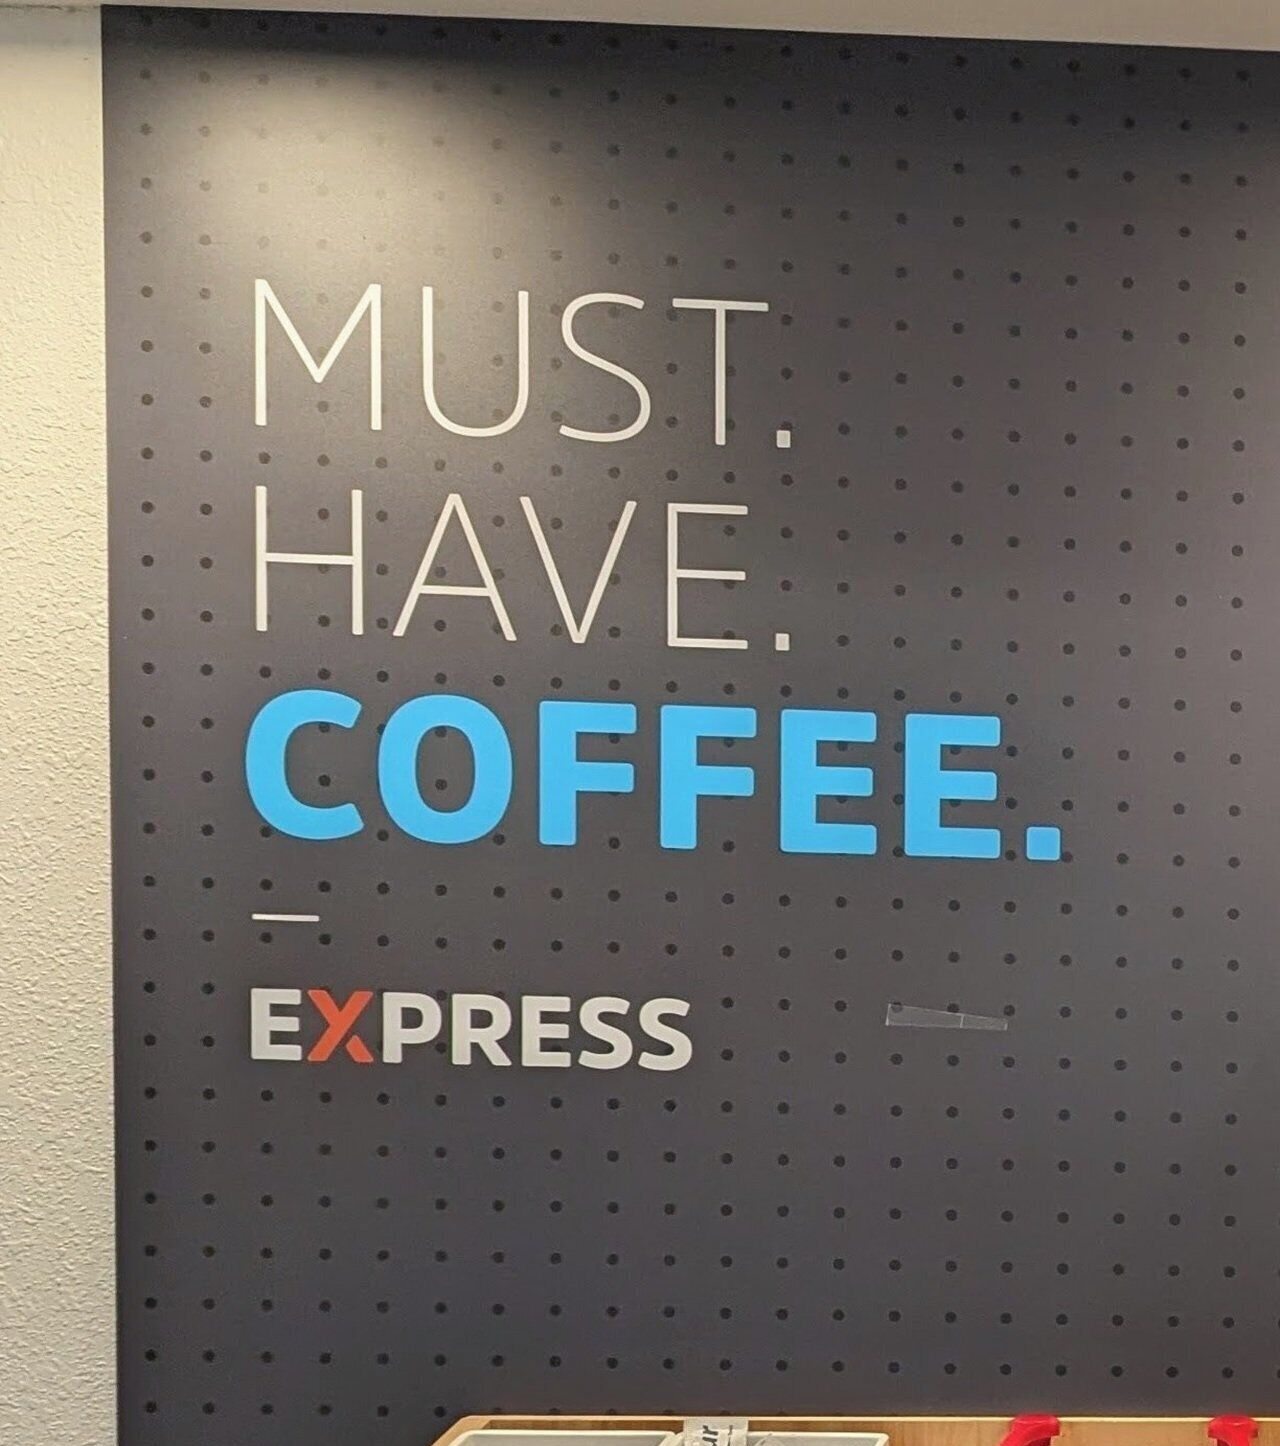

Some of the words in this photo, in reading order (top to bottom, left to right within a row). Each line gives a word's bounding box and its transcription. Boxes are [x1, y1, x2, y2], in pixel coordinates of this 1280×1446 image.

[254, 278, 792, 449] MUST.
[254, 485, 790, 652] HAVE.
[244, 689, 1062, 862] COFFEE.
[249, 987, 693, 1072] EXPRESS
